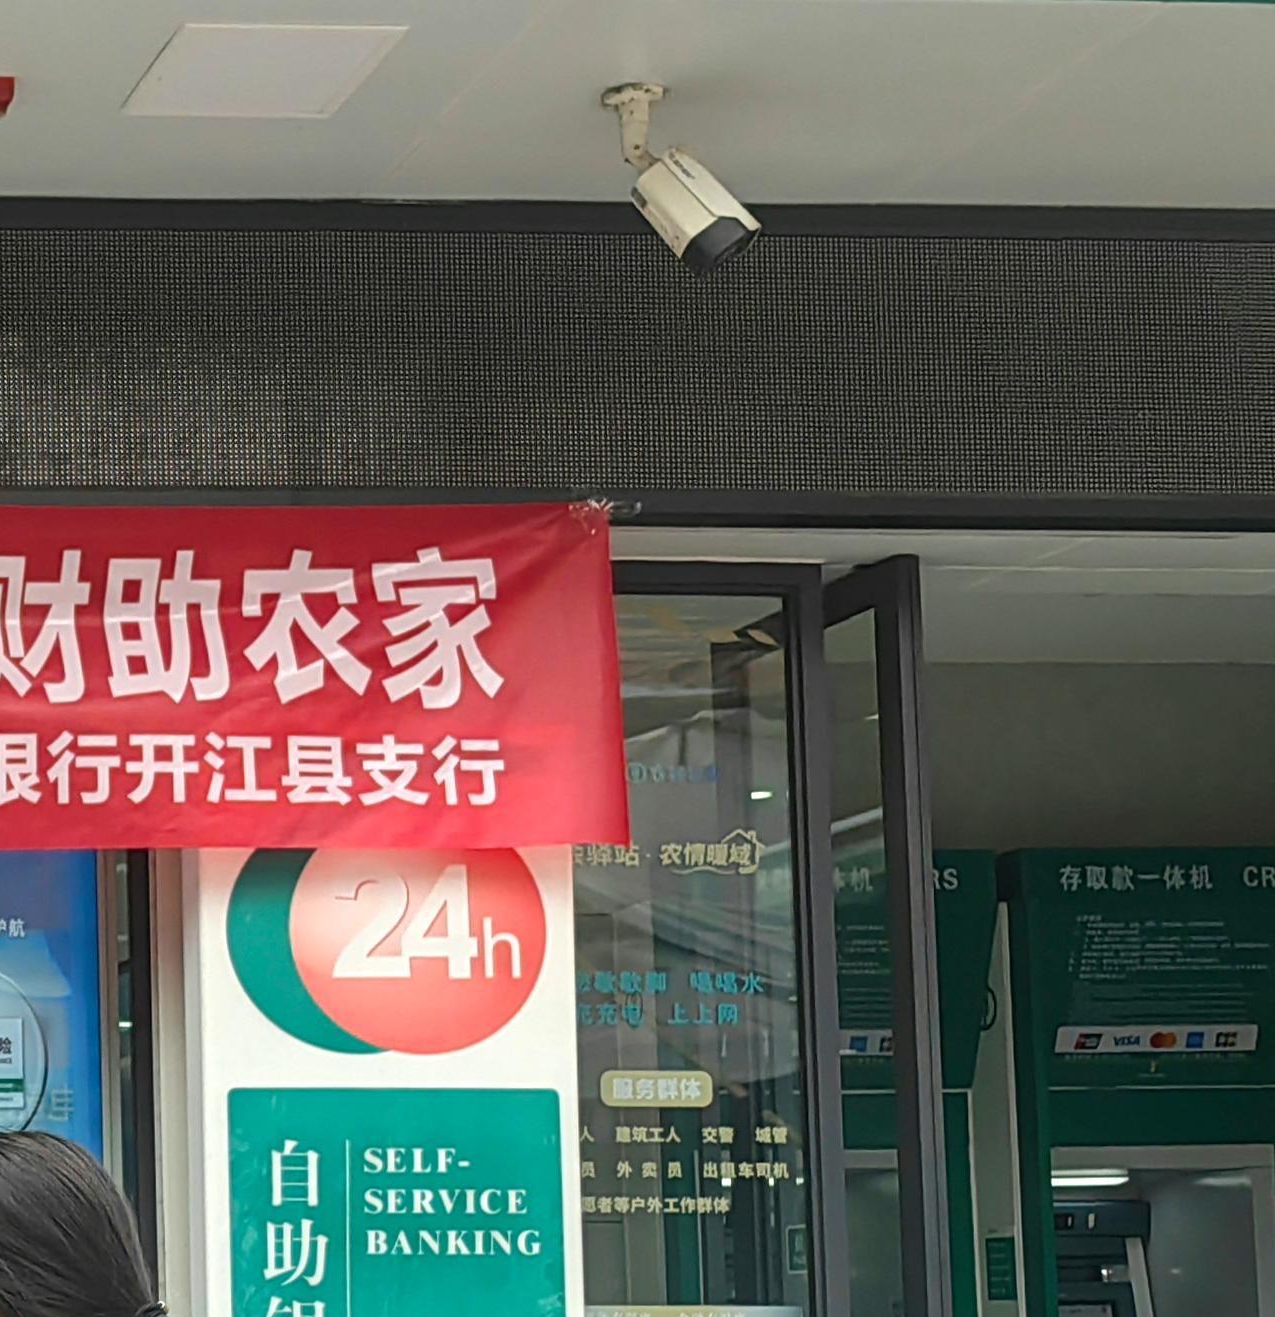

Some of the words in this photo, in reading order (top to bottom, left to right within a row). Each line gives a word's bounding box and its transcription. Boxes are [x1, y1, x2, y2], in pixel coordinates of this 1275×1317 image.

[1059, 864, 1214, 891] 存取款一体机
[331, 863, 522, 980] 24h
[667, 1003, 739, 1025] 上上网
[1113, 1035, 1141, 1046] VISA
[612, 1077, 701, 1100] 服务群体
[615, 1126, 681, 1144] 建筑工人
[701, 1126, 734, 1144] 交警
[754, 1127, 788, 1144] 城管
[363, 1146, 471, 1174] SELF-
[363, 1188, 528, 1215] SERVICE
[365, 1229, 542, 1256] BANKING
